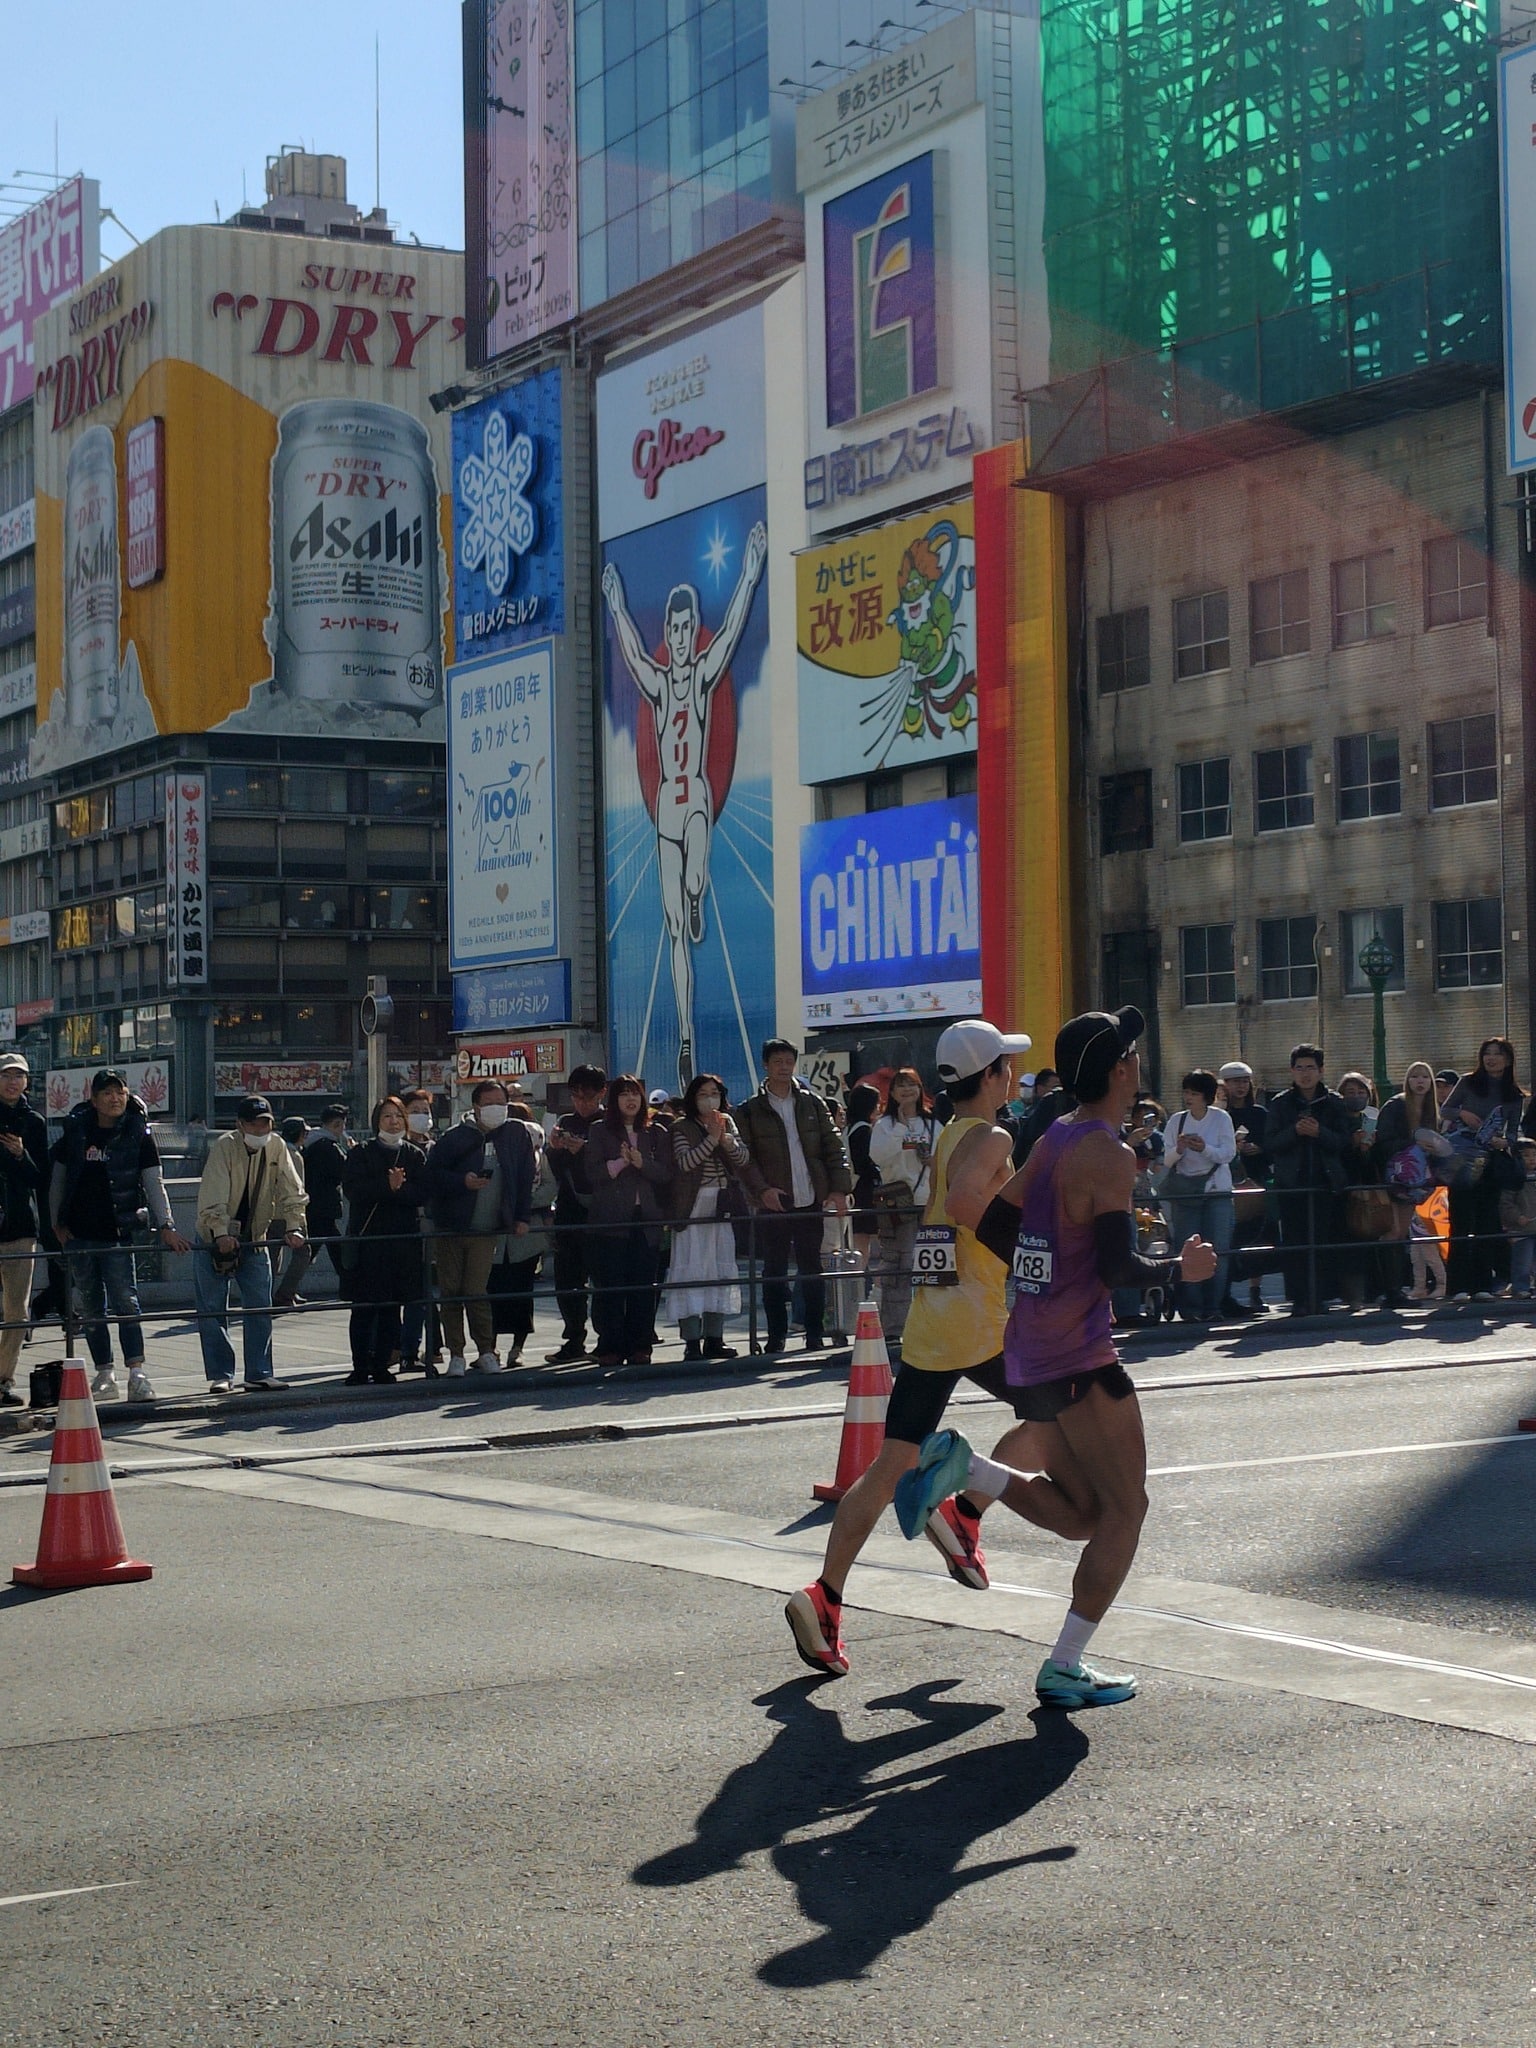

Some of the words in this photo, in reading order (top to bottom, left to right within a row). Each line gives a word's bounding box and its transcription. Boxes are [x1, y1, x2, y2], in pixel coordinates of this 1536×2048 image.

[837, 53, 926, 120] 夢ある住まい
[824, 80, 943, 168] エステムシリーズ
[301, 263, 416, 300] SUPER
[504, 252, 547, 307] ピップ
[69, 275, 120, 336] SUPER
[333, 457, 382, 472] SUPER
[632, 418, 725, 500] Glico
[804, 406, 975, 510] 日商エステム
[290, 500, 423, 570] Asahi
[341, 571, 375, 596] 生
[815, 551, 877, 594] かぜに
[320, 617, 399, 635] スーパードライ
[809, 584, 884, 654] 改源
[409, 662, 435, 690] お酒
[460, 672, 542, 720] 創業100周年
[471, 715, 531, 754] ありがとう
[672, 703, 690, 805] グリコ
[483, 787, 532, 824] 100th
[183, 806, 200, 875] 本場の味
[473, 847, 534, 874] Anniversary
[810, 821, 980, 971] CHINTAI
[489, 991, 550, 1018] 雪印メグミルク
[472, 1054, 529, 1078] ZETTERIA
[918, 1249, 947, 1270] 69
